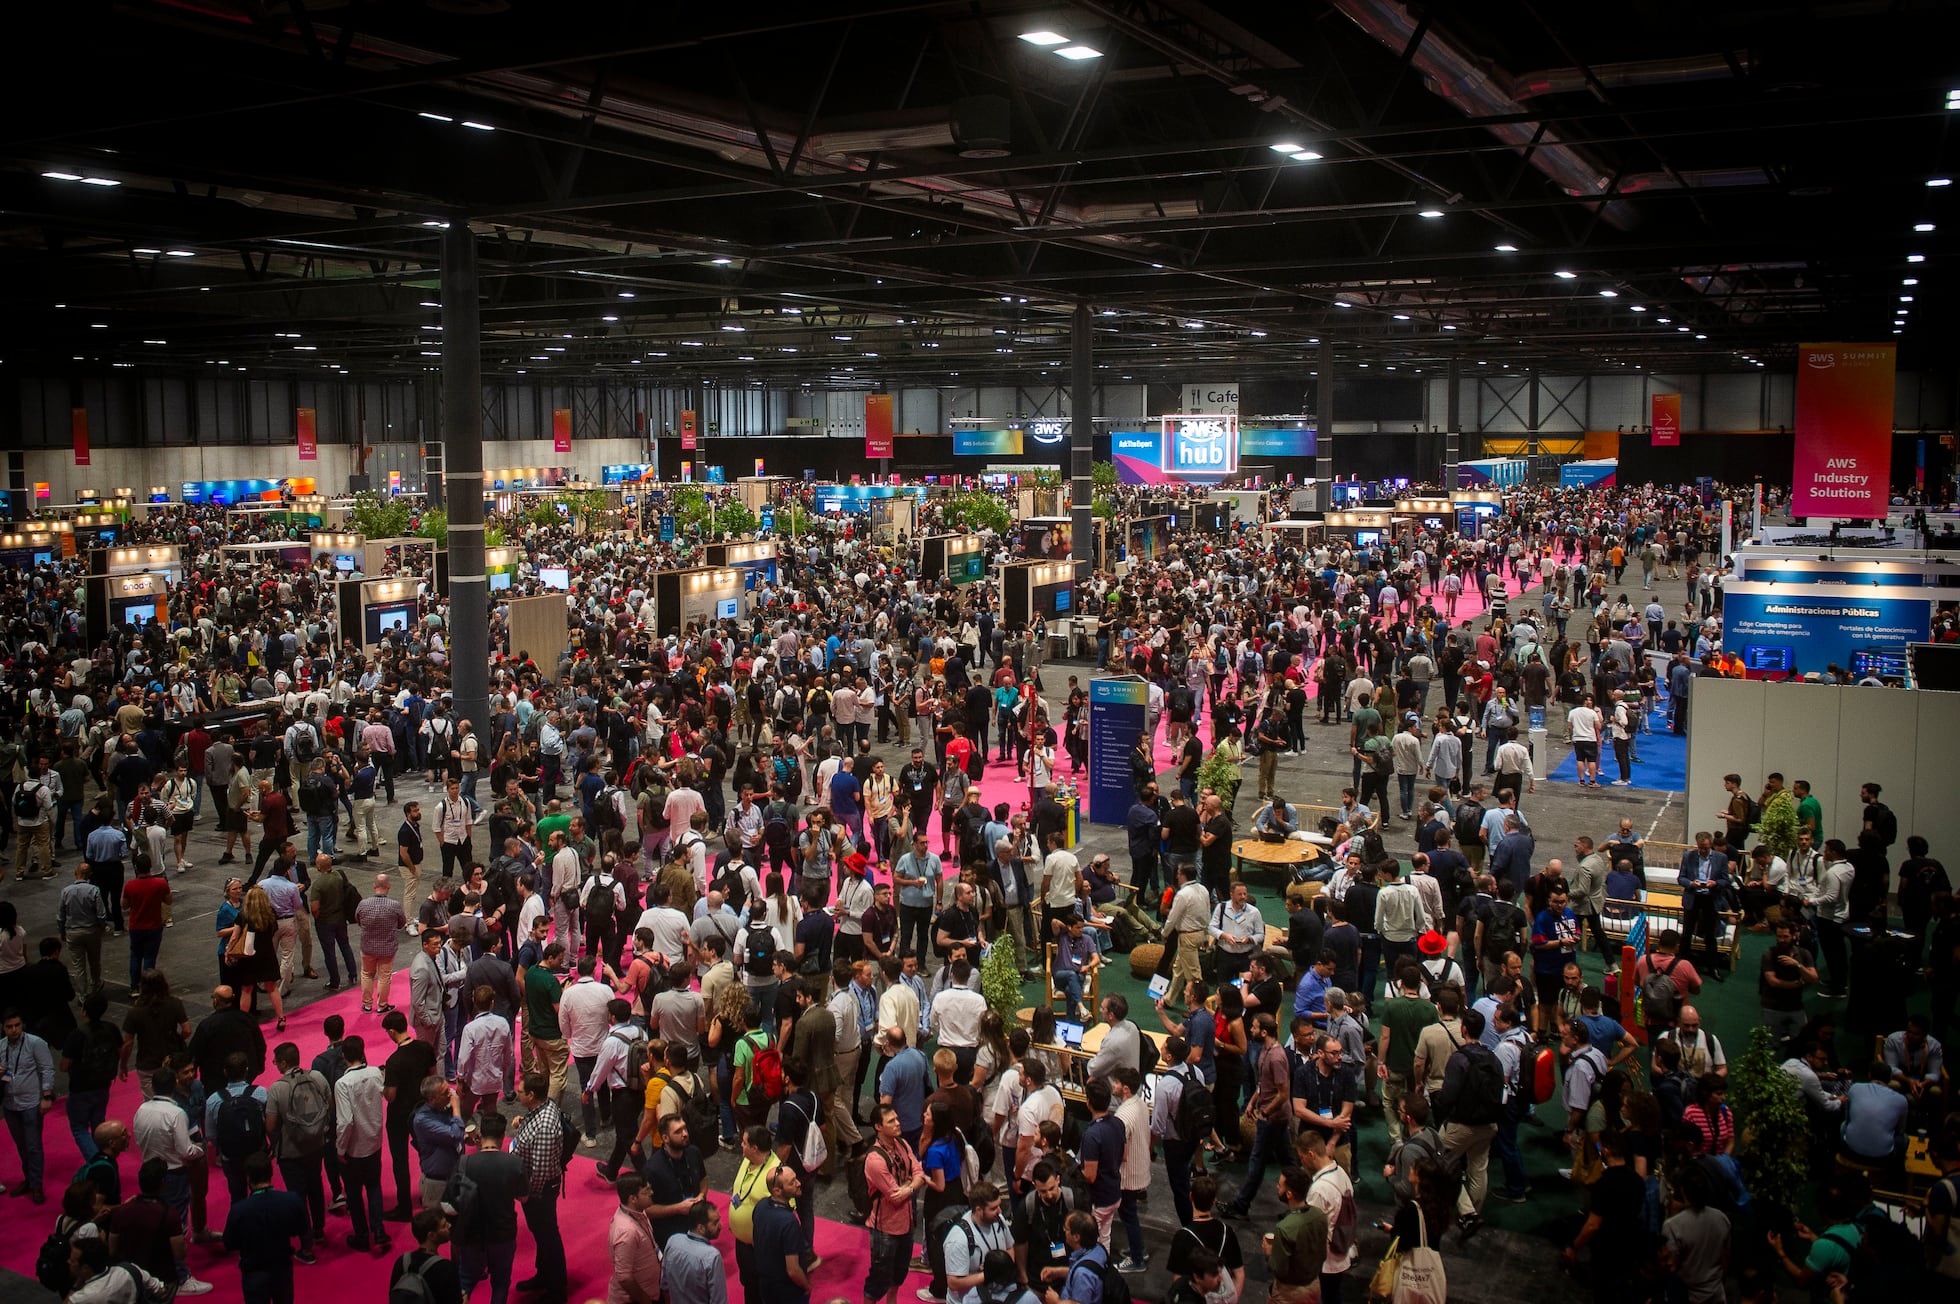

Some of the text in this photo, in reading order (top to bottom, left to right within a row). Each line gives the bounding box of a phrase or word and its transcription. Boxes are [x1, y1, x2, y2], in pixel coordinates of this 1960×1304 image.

[1809, 352, 1887, 365] aws SUMMIT
[1034, 423, 1063, 439] aws
[1180, 441, 1223, 464] hub
[1826, 458, 1857, 469] AWS
[1814, 473, 1869, 486] Industry
[1809, 487, 1871, 499] Solutions
[1765, 604, 1880, 618] Administraciones Públicas
[1732, 627, 1767, 636] despliegues
[1739, 621, 1754, 630] Edge
[1755, 621, 1788, 630] Computing
[1839, 624, 1863, 632] Portales
[1874, 626, 1917, 635] Conocimiento
